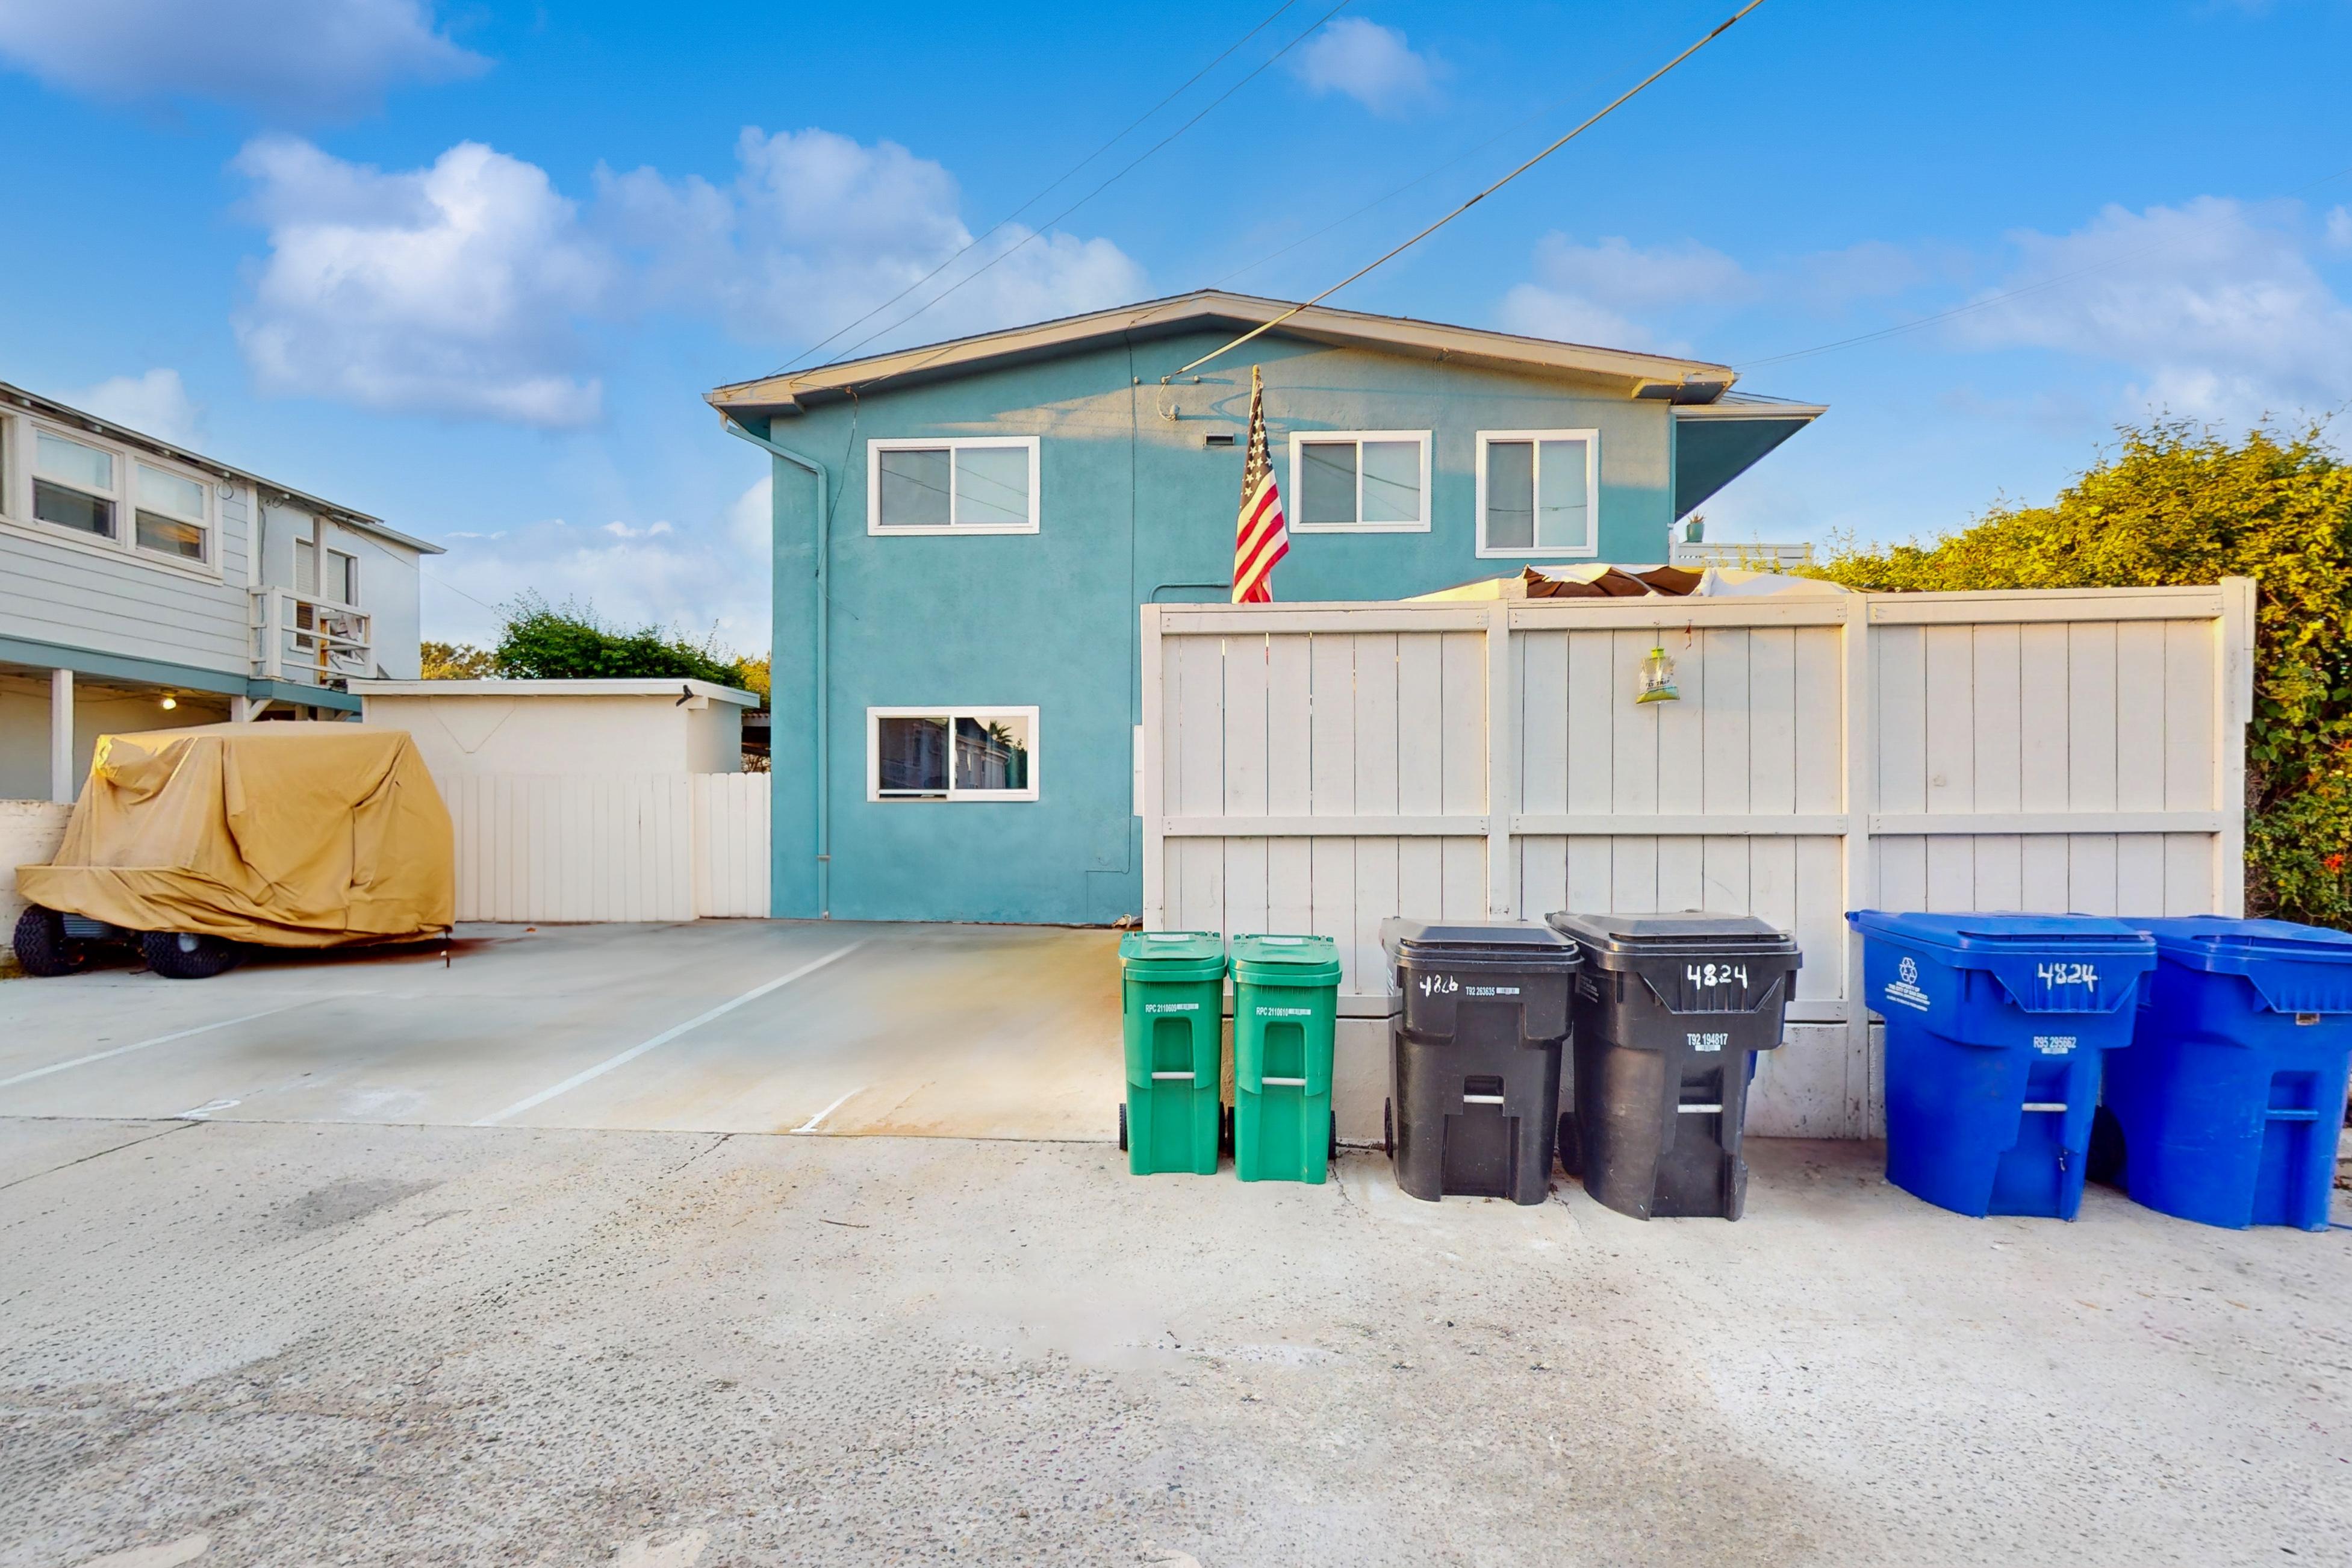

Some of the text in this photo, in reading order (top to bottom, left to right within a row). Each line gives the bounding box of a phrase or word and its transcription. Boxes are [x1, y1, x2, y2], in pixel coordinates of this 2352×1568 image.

[1687, 963, 1747, 990] 4824
[2038, 963, 2098, 992] 4824
[1465, 986, 1495, 997] T92 263635
[1145, 1004, 1156, 1013] RPC
[1256, 1007, 1289, 1016] RPC 2110610
[1687, 1033, 1728, 1046] T92 194817
[2033, 1036, 2049, 1048] R95
